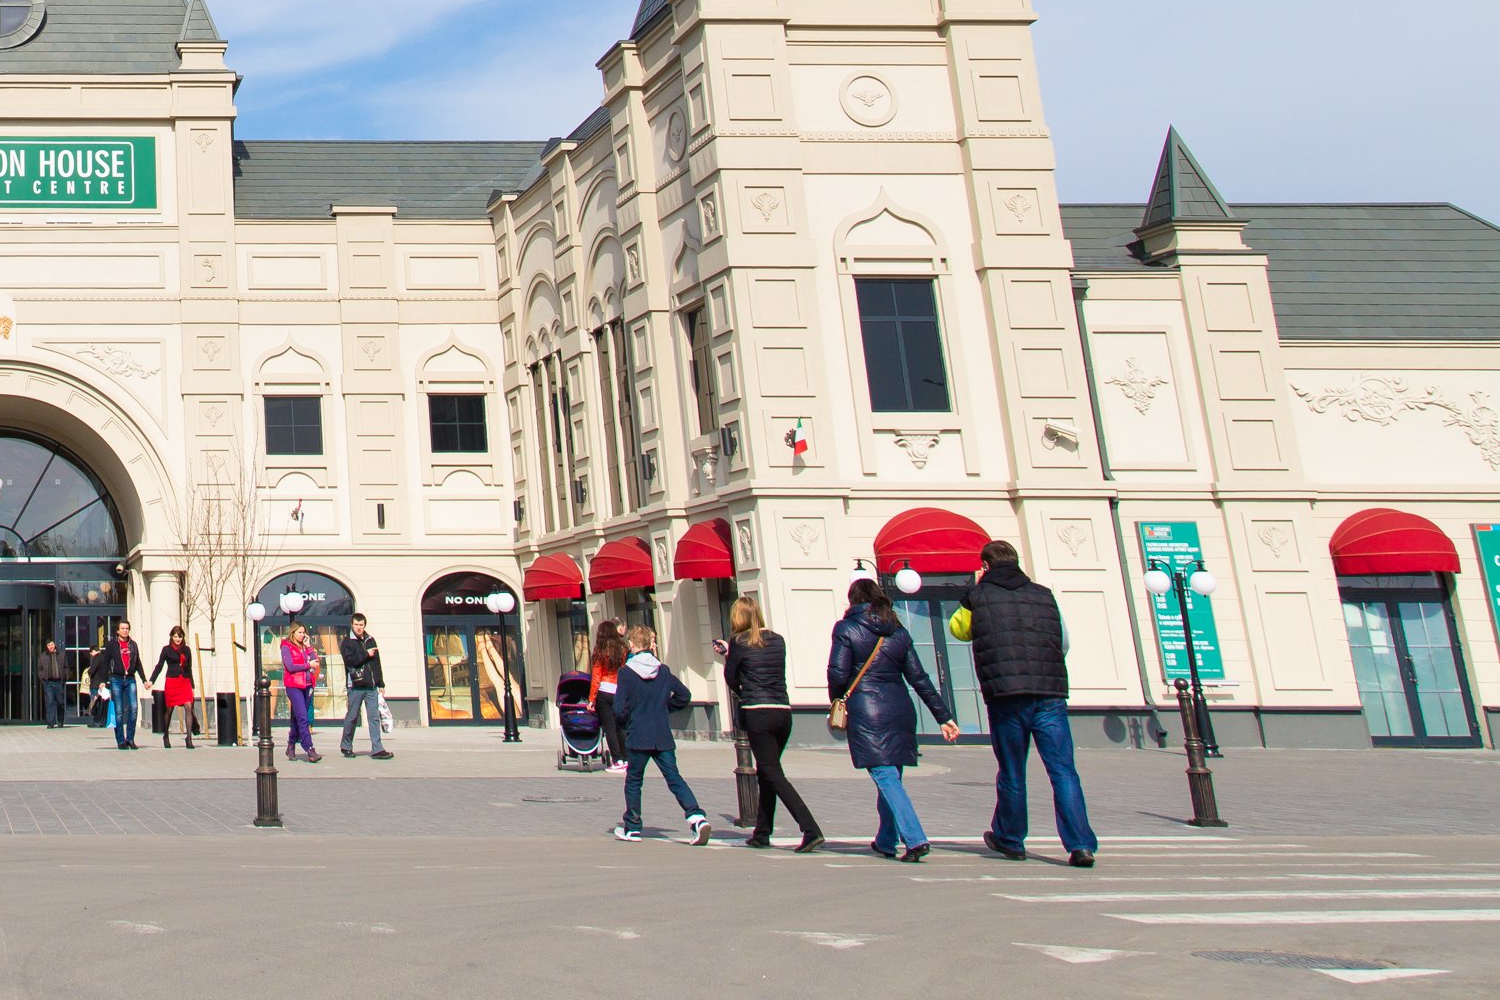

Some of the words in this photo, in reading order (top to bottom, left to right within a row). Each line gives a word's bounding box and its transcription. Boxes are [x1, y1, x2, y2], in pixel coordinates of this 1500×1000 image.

[39, 149, 125, 178] HOUSE
[32, 180, 125, 195] CENTRE
[300, 593, 326, 601] ONE
[445, 596, 463, 605] NO
